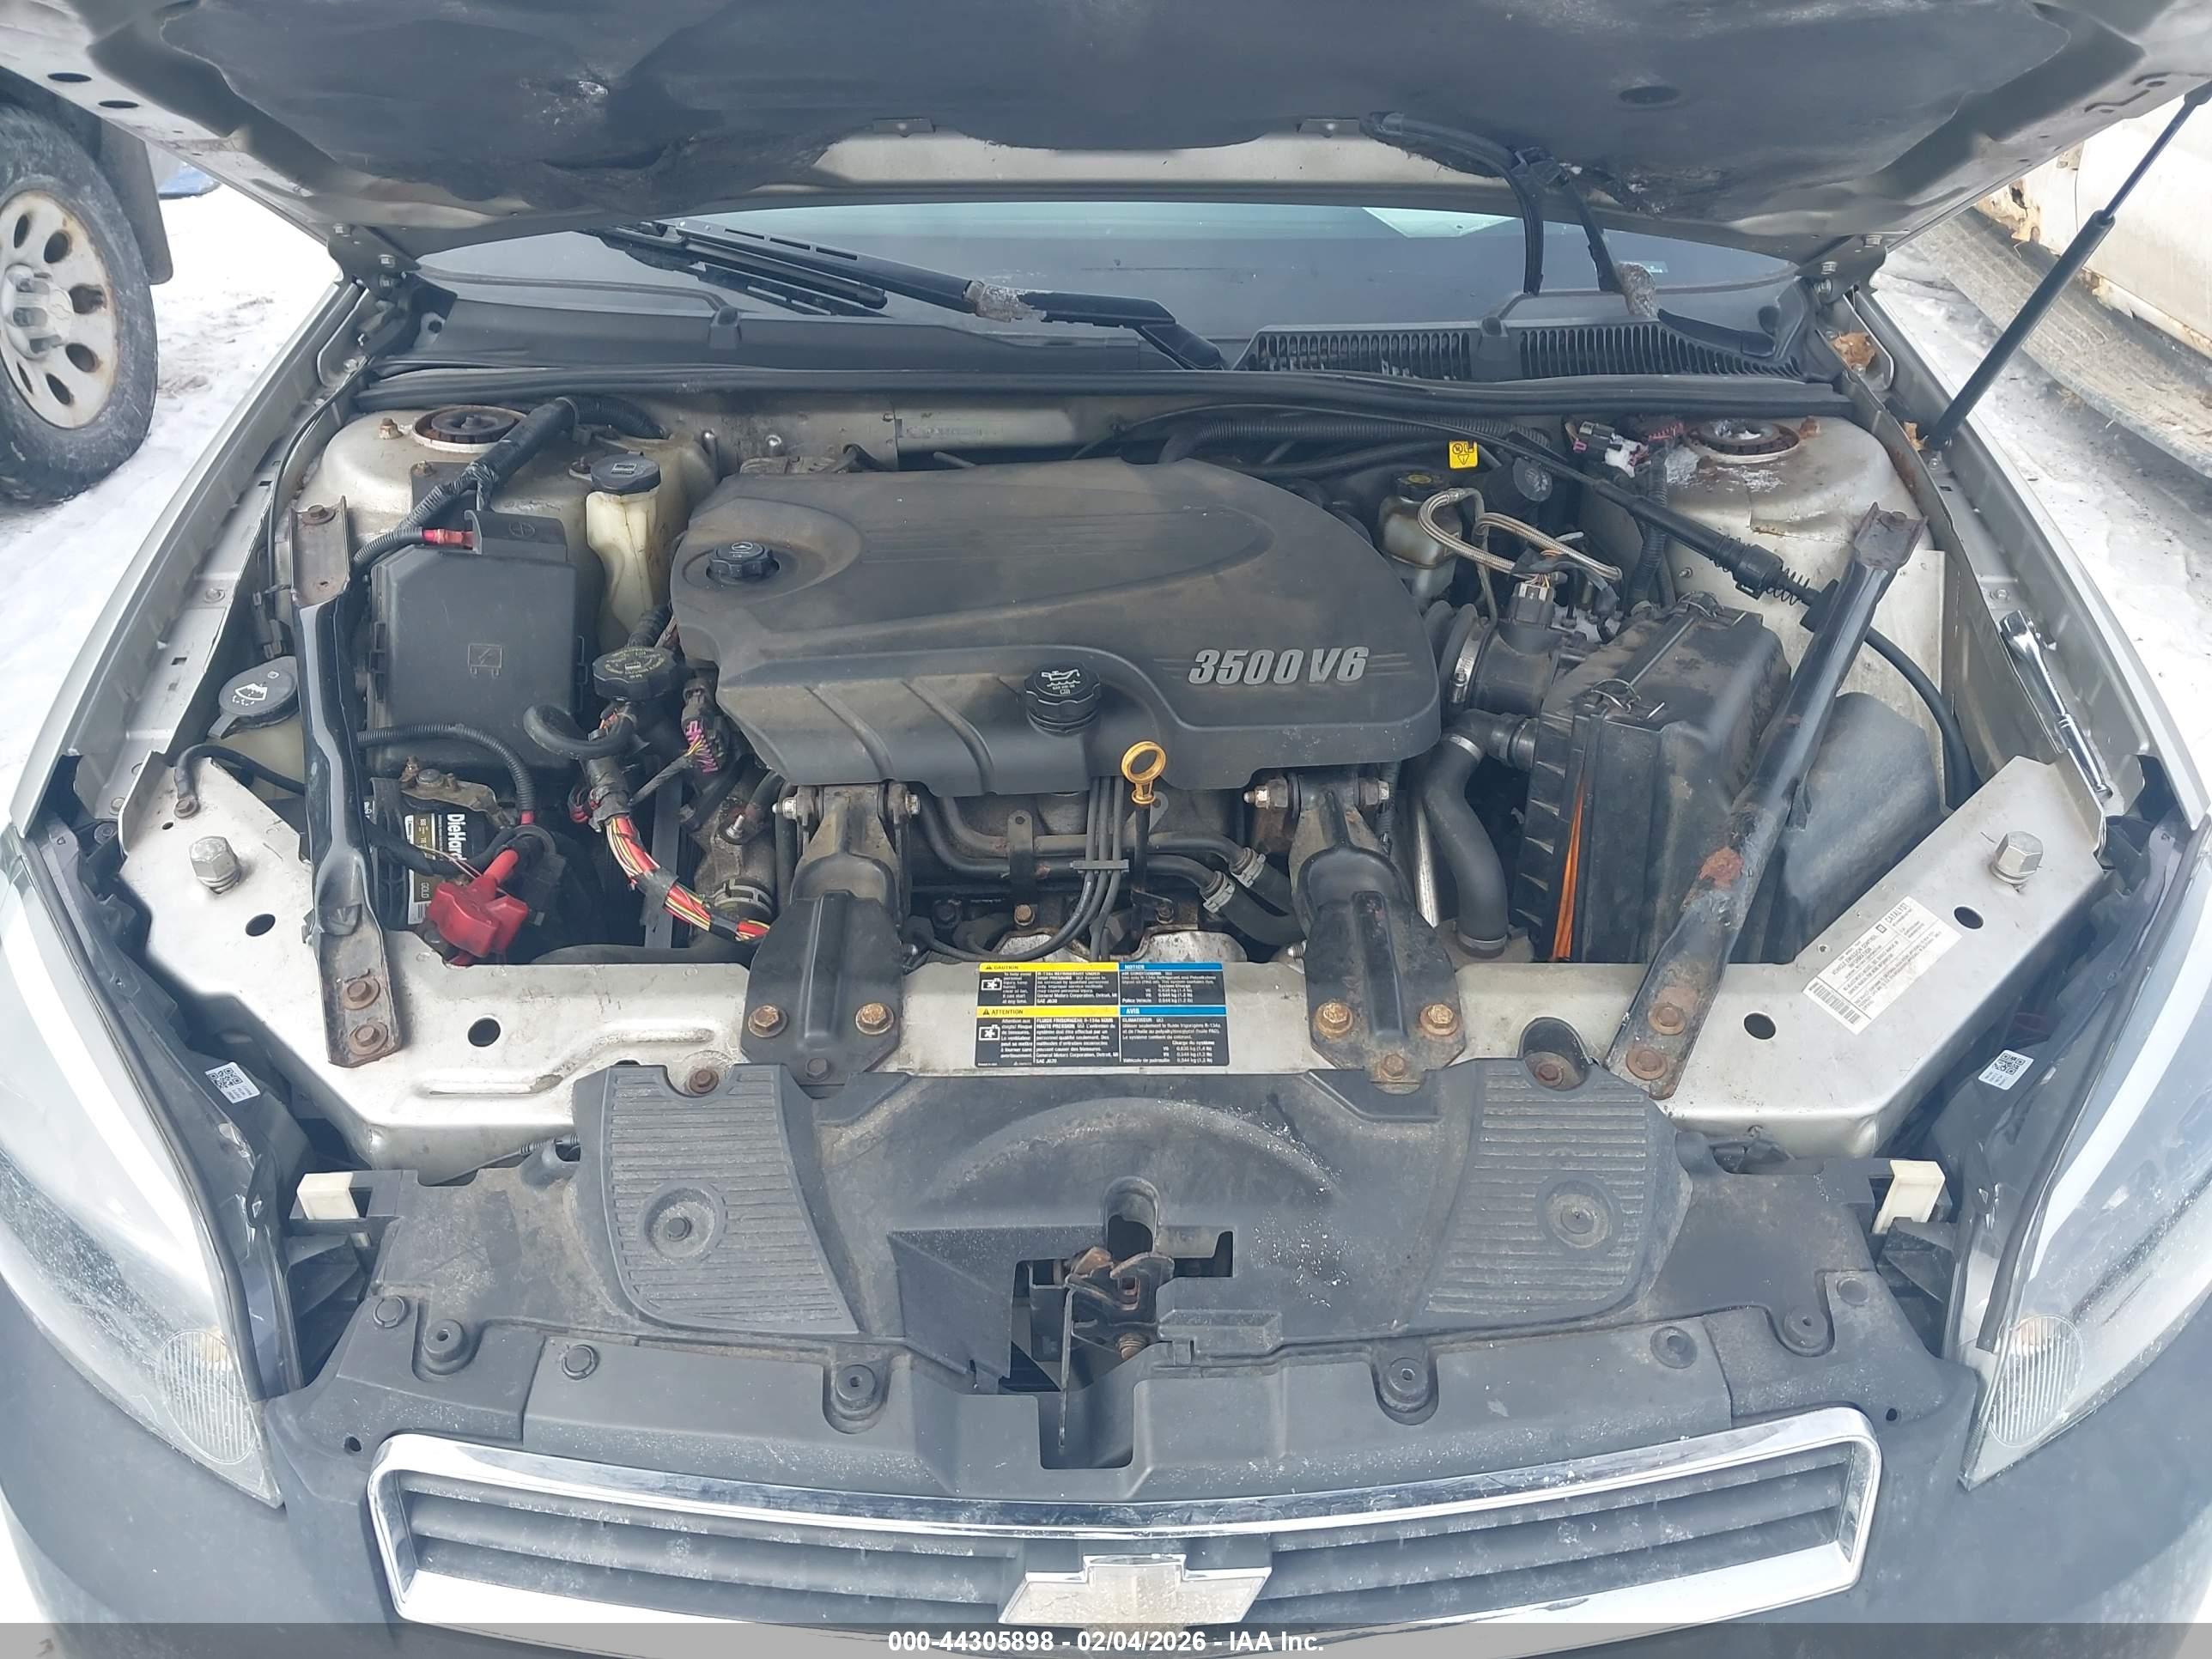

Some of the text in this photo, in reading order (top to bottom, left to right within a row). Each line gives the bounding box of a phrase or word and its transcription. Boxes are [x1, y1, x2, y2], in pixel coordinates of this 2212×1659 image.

[1188, 647, 1369, 684] 3500 V6
[447, 813, 467, 861] DieHard
[421, 882, 429, 899] GOLD
